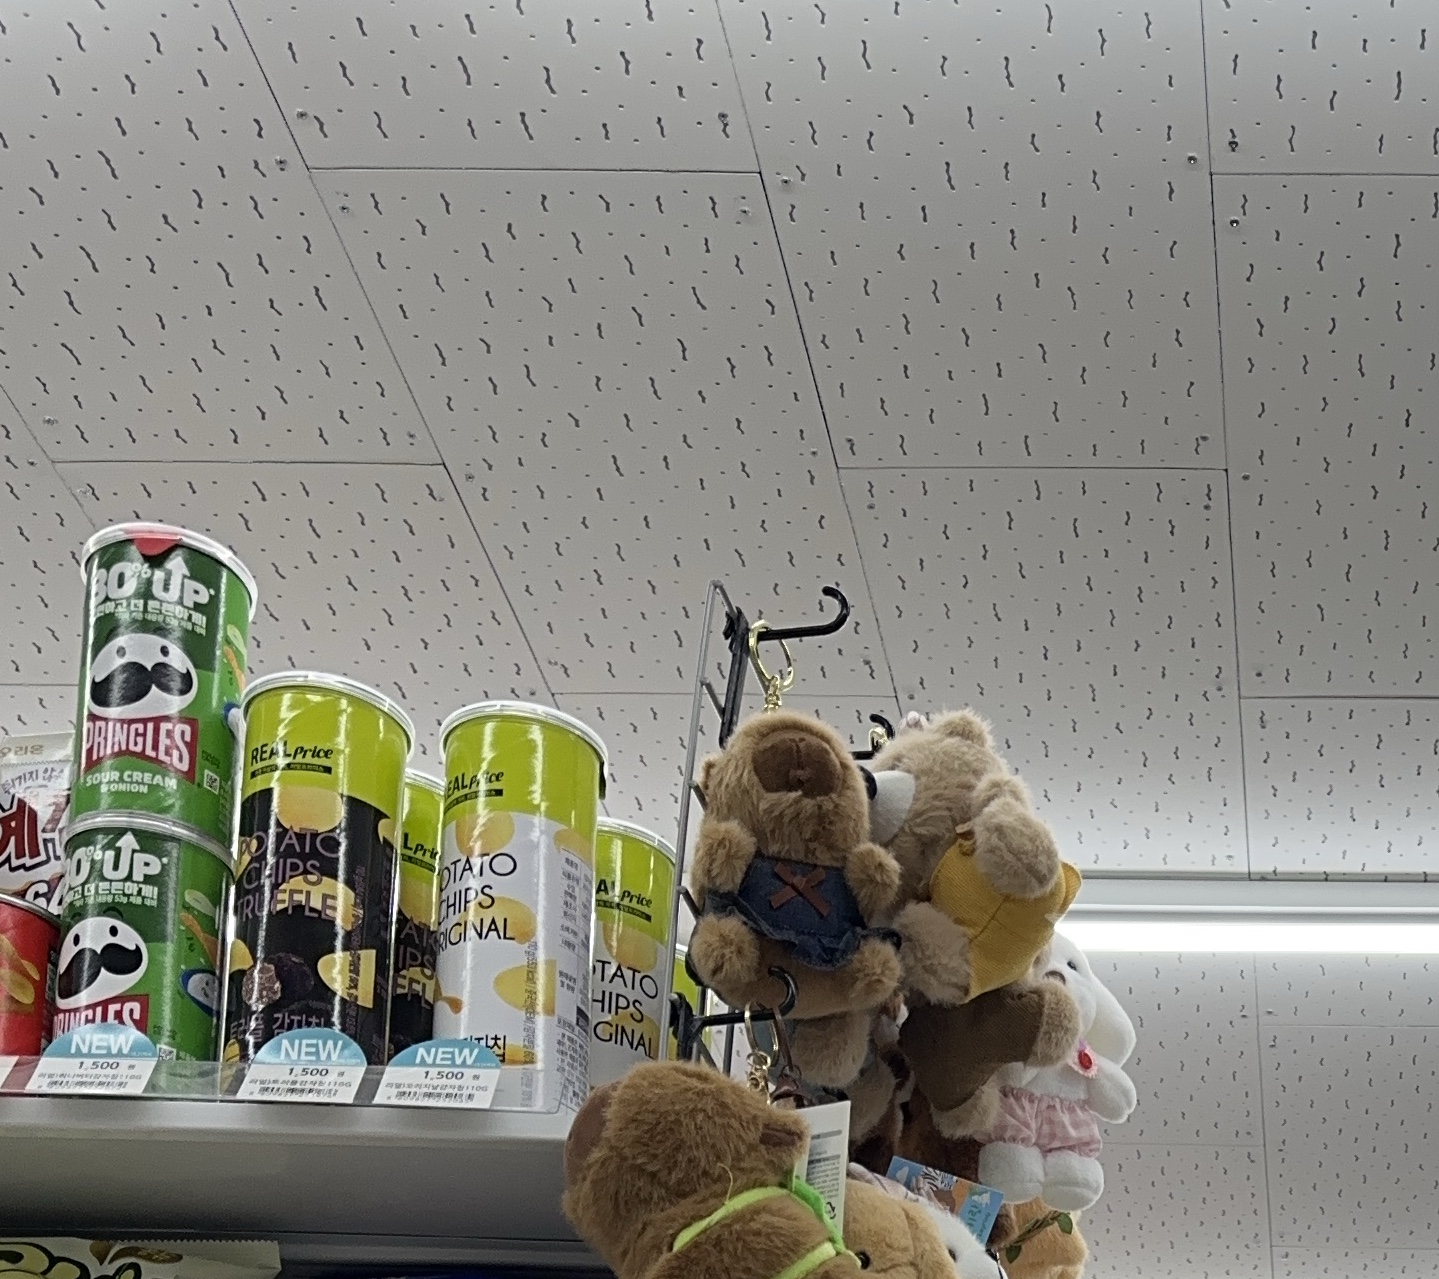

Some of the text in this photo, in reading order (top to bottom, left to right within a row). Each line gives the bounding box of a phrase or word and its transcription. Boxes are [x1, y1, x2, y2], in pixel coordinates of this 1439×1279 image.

[86, 718, 192, 773] PRINGLES
[86, 770, 178, 791] SOUR CREAM
[240, 826, 343, 859] POTATO
[243, 858, 324, 890] CHIPS
[440, 852, 518, 893] OTATO
[237, 888, 339, 922] TRUFFLE
[439, 918, 515, 954] RIGINAL
[593, 958, 659, 1001] TATO
[592, 989, 645, 1024] HIPS
[70, 1034, 134, 1055] NEW
[280, 1039, 343, 1062] NEW
[593, 1020, 654, 1060] GINAL
[78, 1061, 120, 1072] 1,500
[287, 1067, 329, 1078] 1,500
[415, 1047, 480, 1066] NEW
[423, 1071, 464, 1082] 1,500
